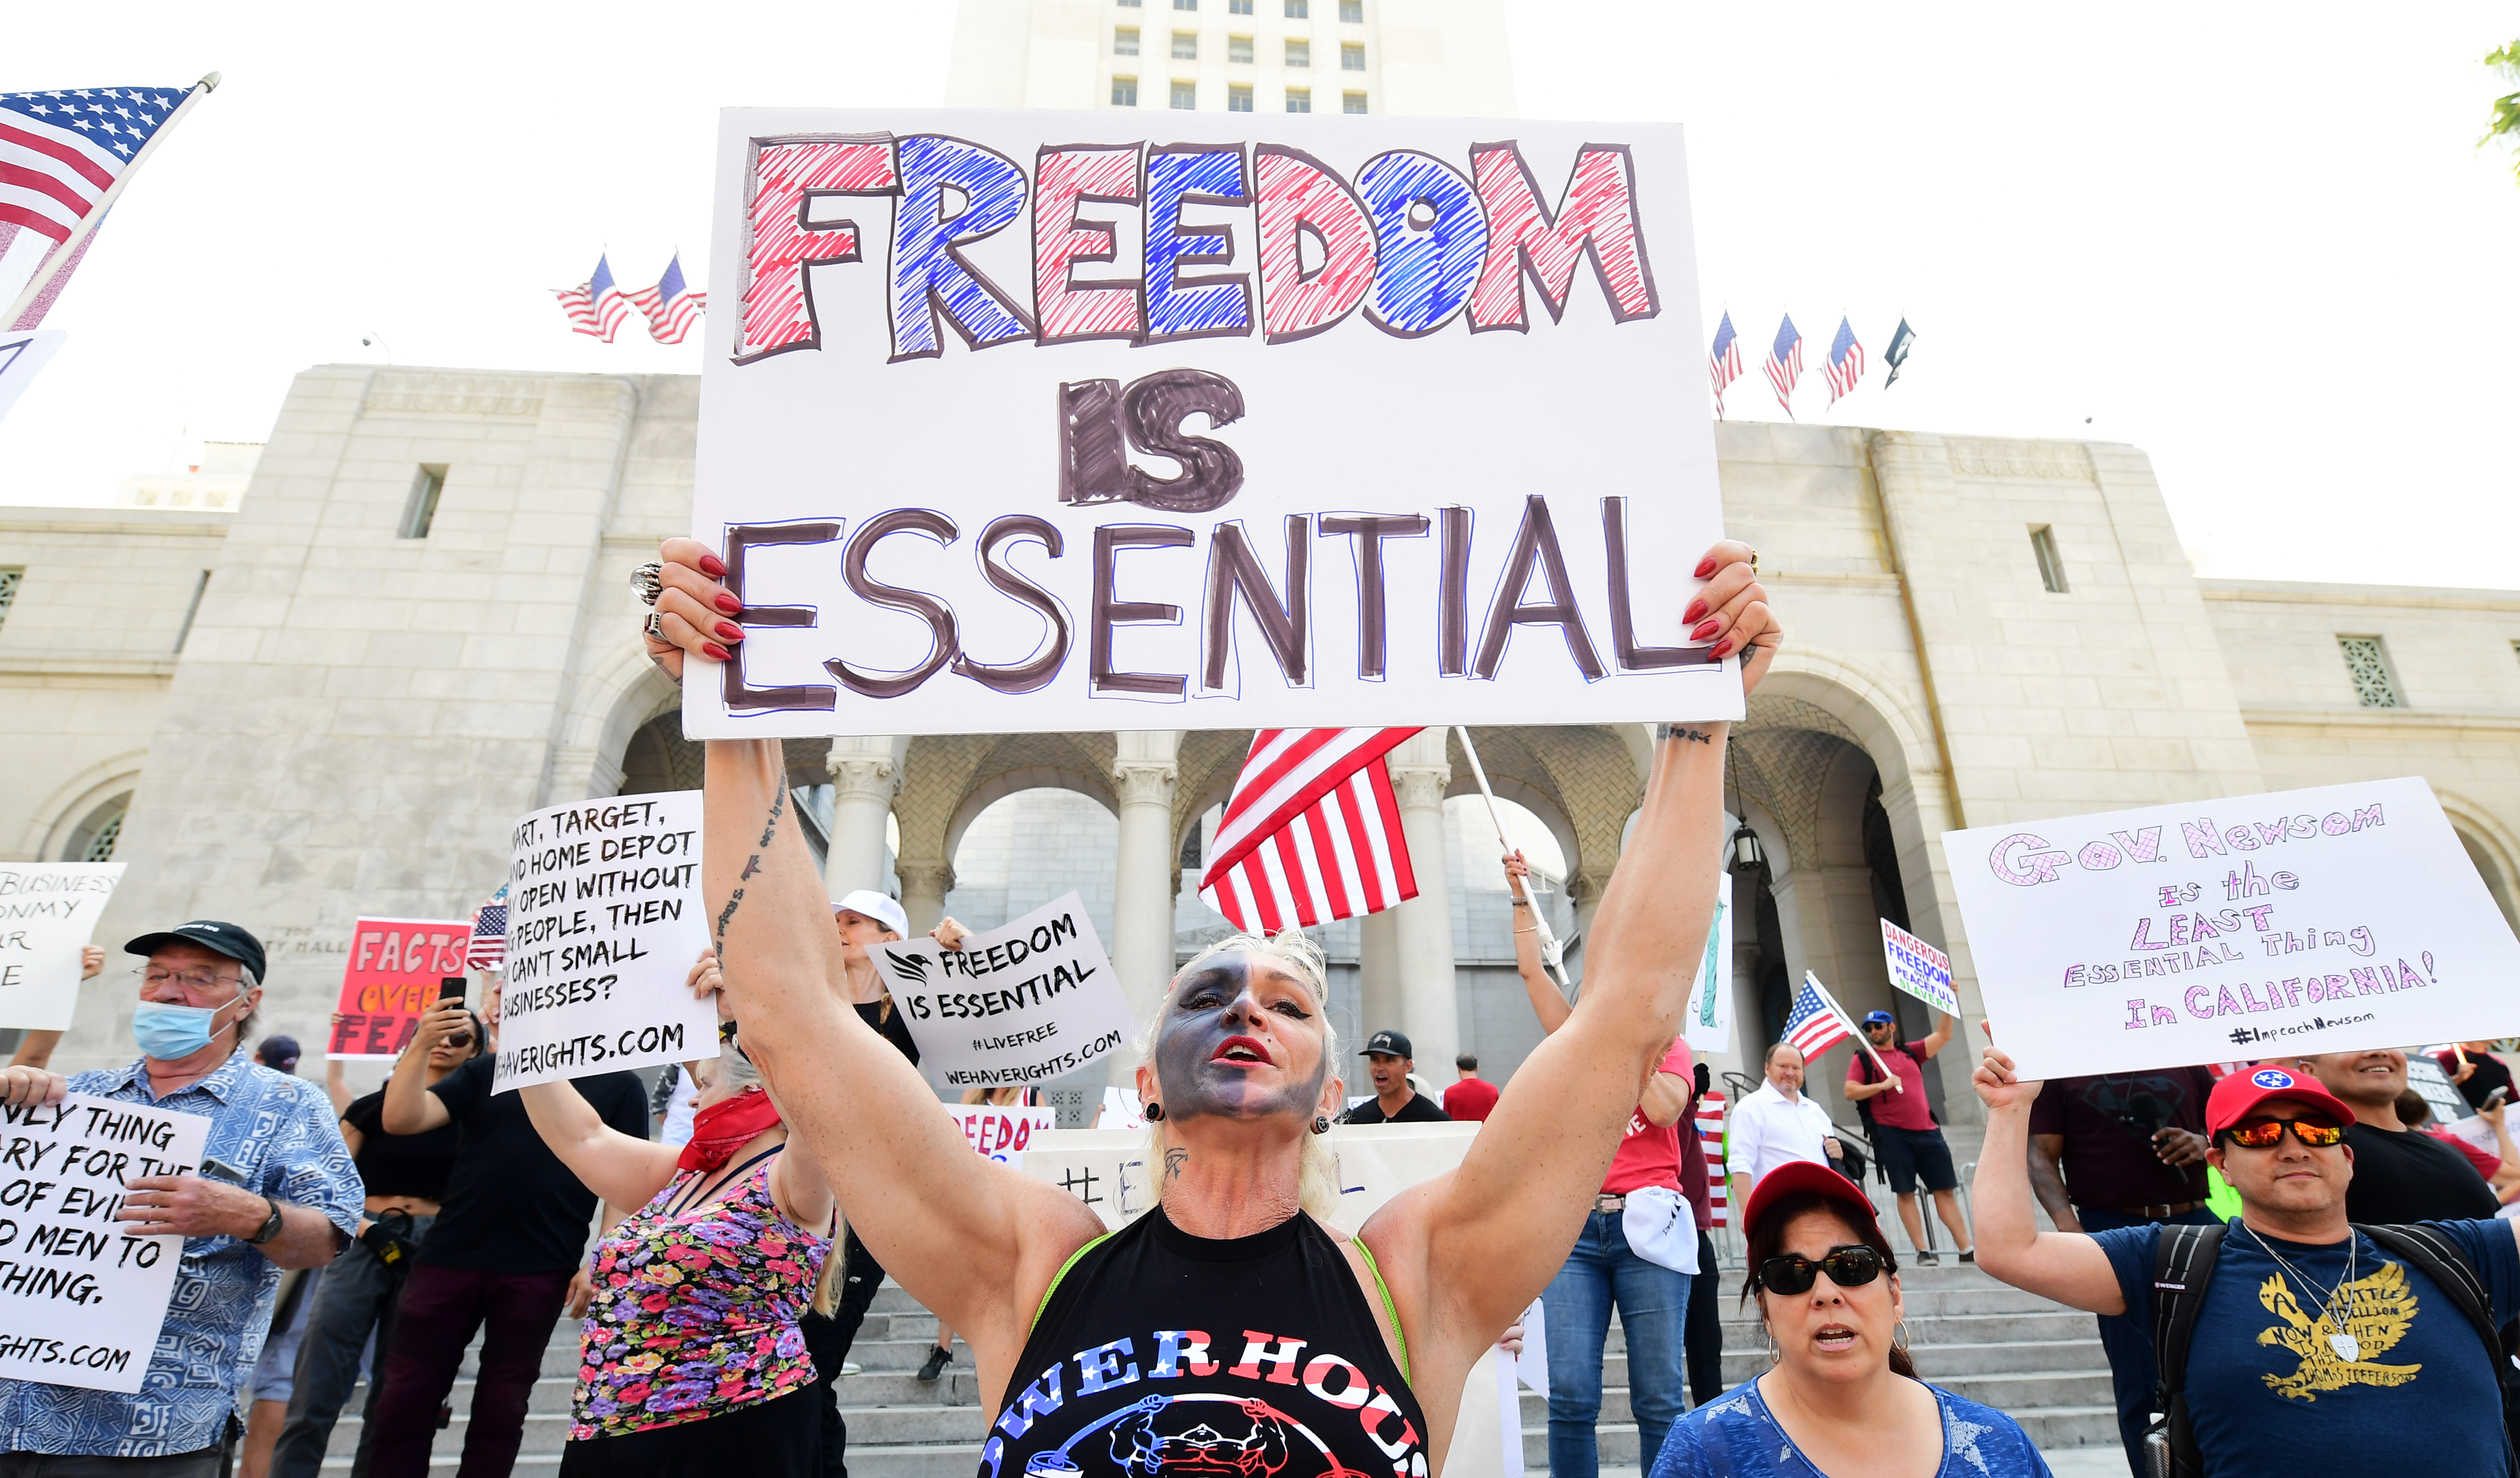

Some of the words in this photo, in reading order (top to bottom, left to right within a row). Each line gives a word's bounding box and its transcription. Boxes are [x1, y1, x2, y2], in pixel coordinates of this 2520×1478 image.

[730, 131, 1661, 365] FREEDOM
[1057, 368, 1246, 512] IS
[722, 494, 1724, 716] ESSENTIAL
[551, 801, 665, 838] TARGET,
[532, 842, 591, 875] HOME
[602, 831, 696, 862] DEPOT
[520, 880, 566, 913] OPEN
[576, 863, 698, 899] WITHOUT
[2221, 860, 2299, 900] the
[518, 910, 595, 950] PEOPLE,
[606, 898, 682, 930] THEN
[939, 913, 1077, 979] FREEDOM
[2130, 904, 2273, 950] LEAST
[355, 931, 467, 973] FACTS
[512, 950, 555, 983] CAN'T
[561, 937, 649, 972] SMALL
[1885, 923, 1949, 971] DANGEROUS
[2063, 943, 2243, 988] ESSENTIAL
[504, 974, 618, 1021] BUSINESSES?
[907, 995, 931, 1020] IS
[938, 959, 1097, 1019] ESSENTIAL
[1895, 965, 1954, 1004] PEACEFUL
[1900, 978, 1951, 1012] SLAVERY
[2184, 951, 2437, 1019] CALIFORNIA!
[944, 1030, 1122, 1085] WEHAVERIGHTS.COM
[972, 1022, 1058, 1051] #LIVEFREE
[85, 1107, 175, 1151] THING
[60, 1146, 129, 1187] FOR
[1, 1179, 56, 1212] OF
[25, 1224, 109, 1261] MEN
[118, 1237, 161, 1268] TO
[2336, 1288, 2401, 1306] LITTLE
[2271, 1325, 2312, 1345] NOW
[2322, 1325, 2333, 1336] &
[2295, 1340, 2318, 1356] IS
[2347, 1368, 2412, 1383] JEFFERSON
